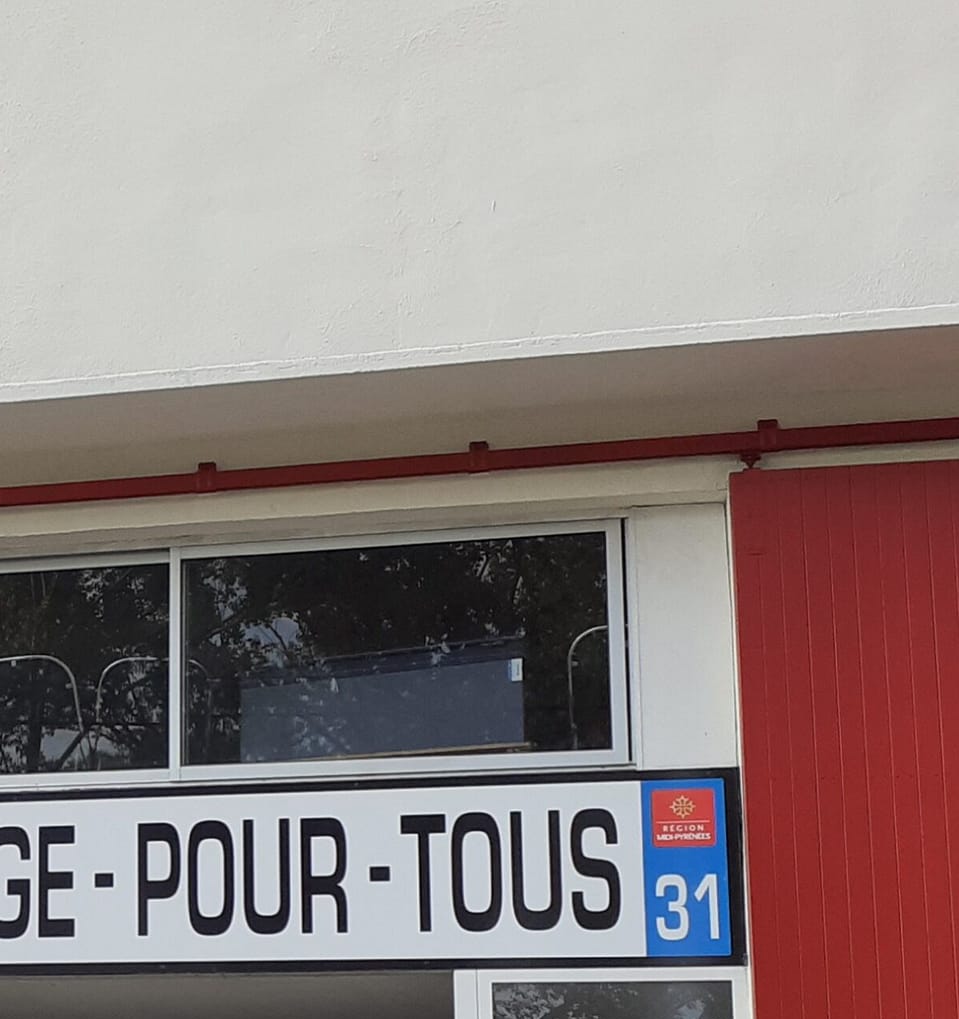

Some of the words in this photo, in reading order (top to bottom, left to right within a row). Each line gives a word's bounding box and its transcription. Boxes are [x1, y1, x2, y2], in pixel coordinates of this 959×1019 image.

[137, 817, 348, 936] POUR
[400, 808, 621, 932] TOUS
[655, 873, 720, 941] 31
